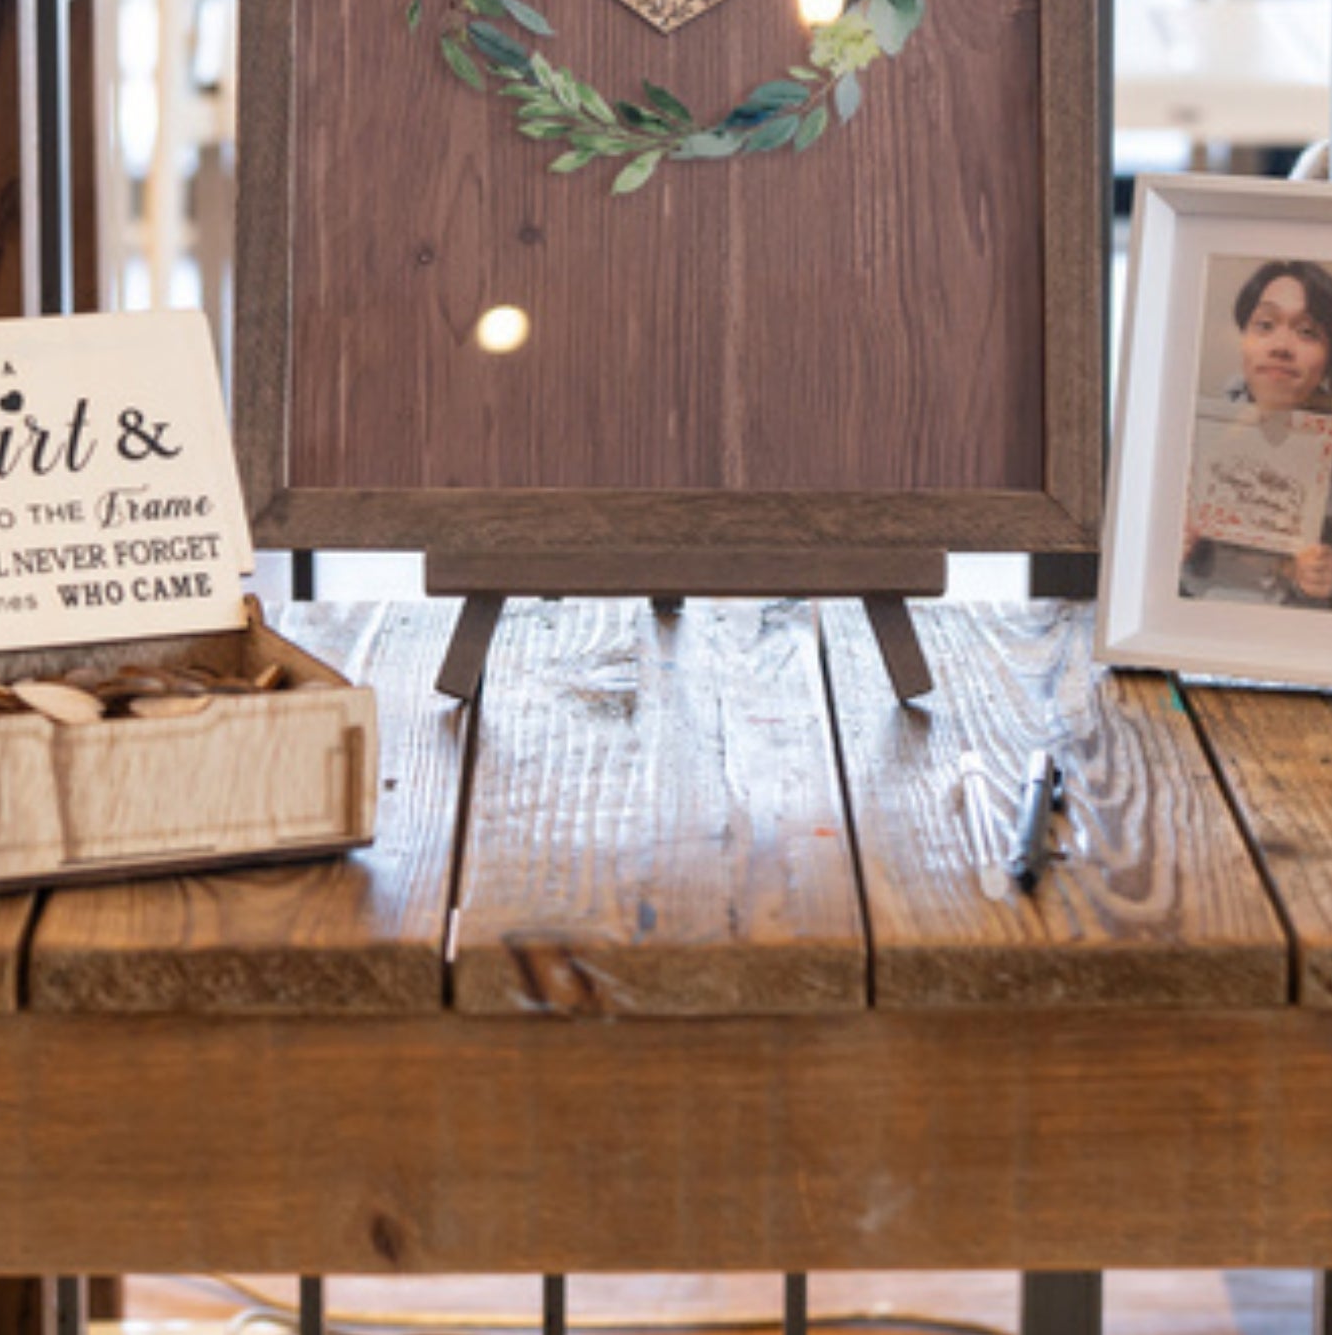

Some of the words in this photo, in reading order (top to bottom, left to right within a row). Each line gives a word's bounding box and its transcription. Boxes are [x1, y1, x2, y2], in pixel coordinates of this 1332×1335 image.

[2, 360, 17, 376] A
[116, 407, 183, 462] &
[26, 498, 85, 525] THE
[95, 484, 215, 529] Frame
[12, 543, 107, 576] NEVER
[113, 531, 220, 566] FORGET
[57, 580, 125, 608] WHO
[131, 571, 213, 602] CAME
